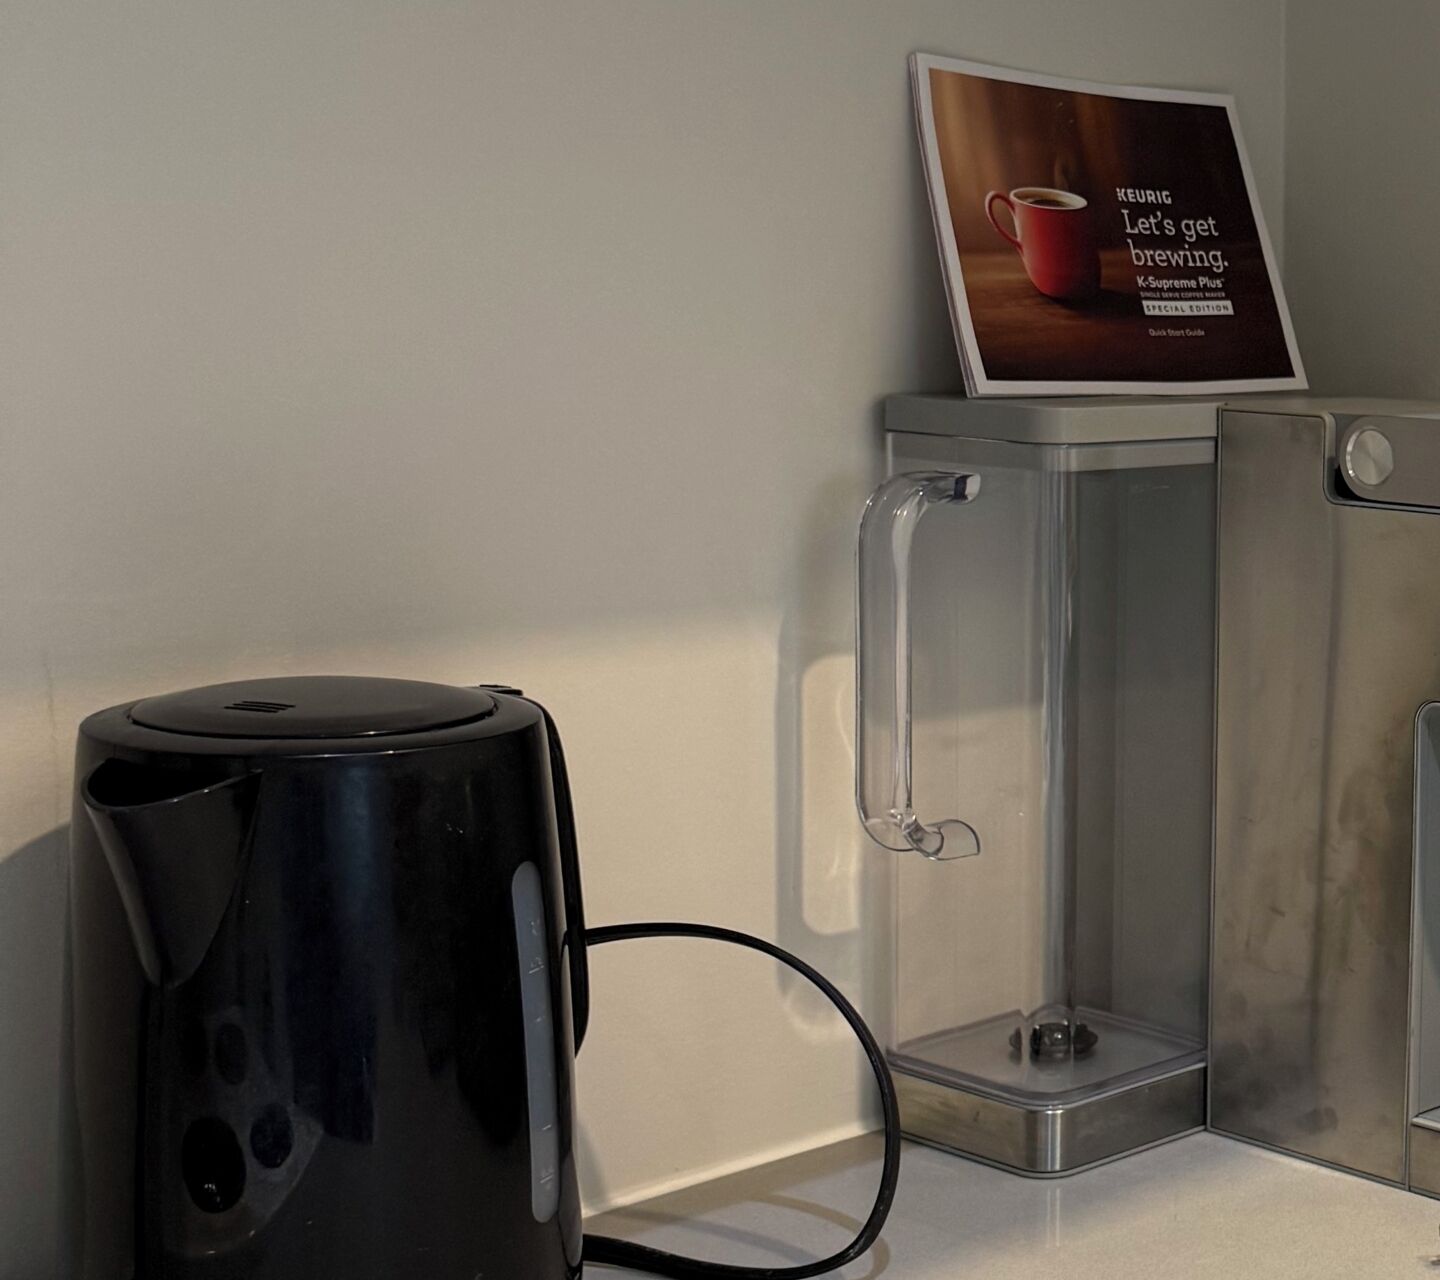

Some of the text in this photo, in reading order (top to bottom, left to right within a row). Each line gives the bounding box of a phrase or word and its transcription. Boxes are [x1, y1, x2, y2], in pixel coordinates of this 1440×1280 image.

[1116, 187, 1172, 205] KEURIG
[1181, 216, 1219, 242] get
[1127, 238, 1229, 273] brewing.
[1136, 275, 1197, 291] K-Supreme
[1146, 304, 1229, 313] SPECIAL EDITION
[1148, 328, 1205, 337] Quick Start Guide
